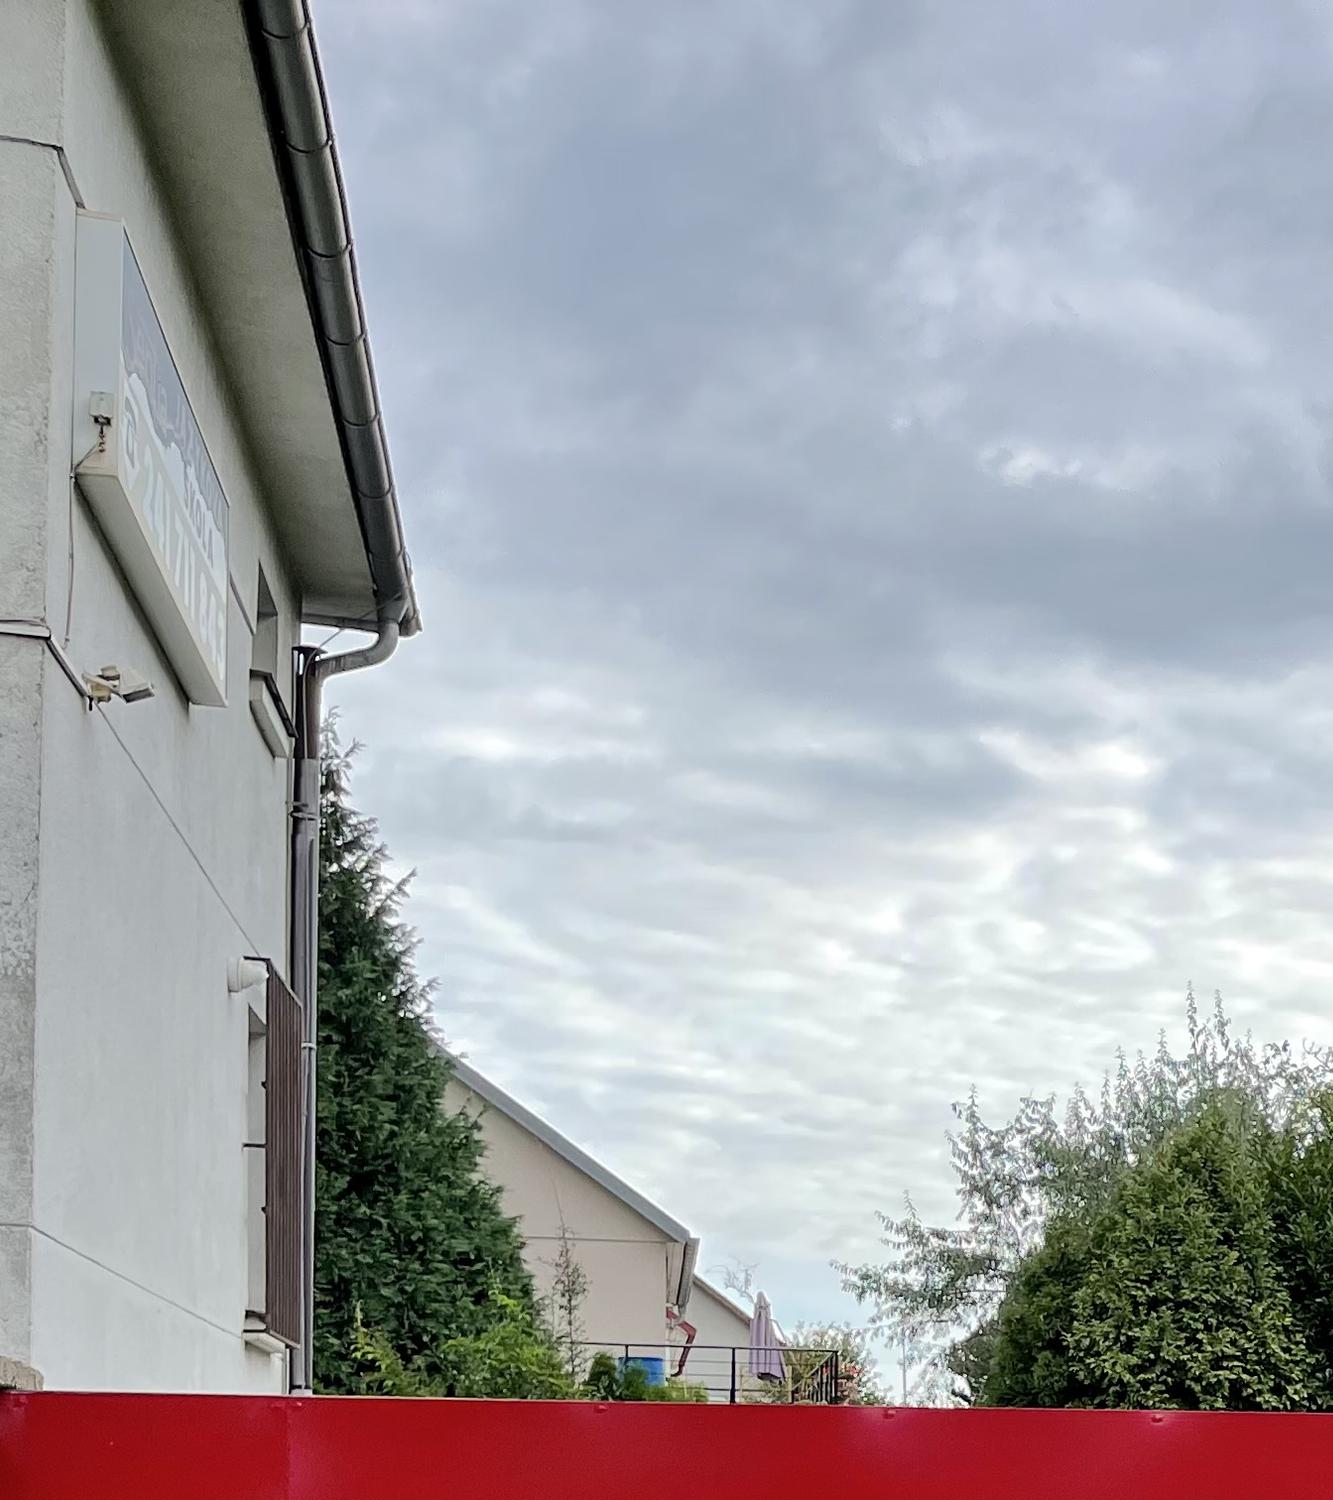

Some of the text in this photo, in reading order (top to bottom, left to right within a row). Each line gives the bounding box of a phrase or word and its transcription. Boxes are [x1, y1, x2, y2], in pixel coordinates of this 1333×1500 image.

[143, 435, 170, 570] 241
[174, 508, 194, 624] 711
[199, 563, 224, 686] 843
